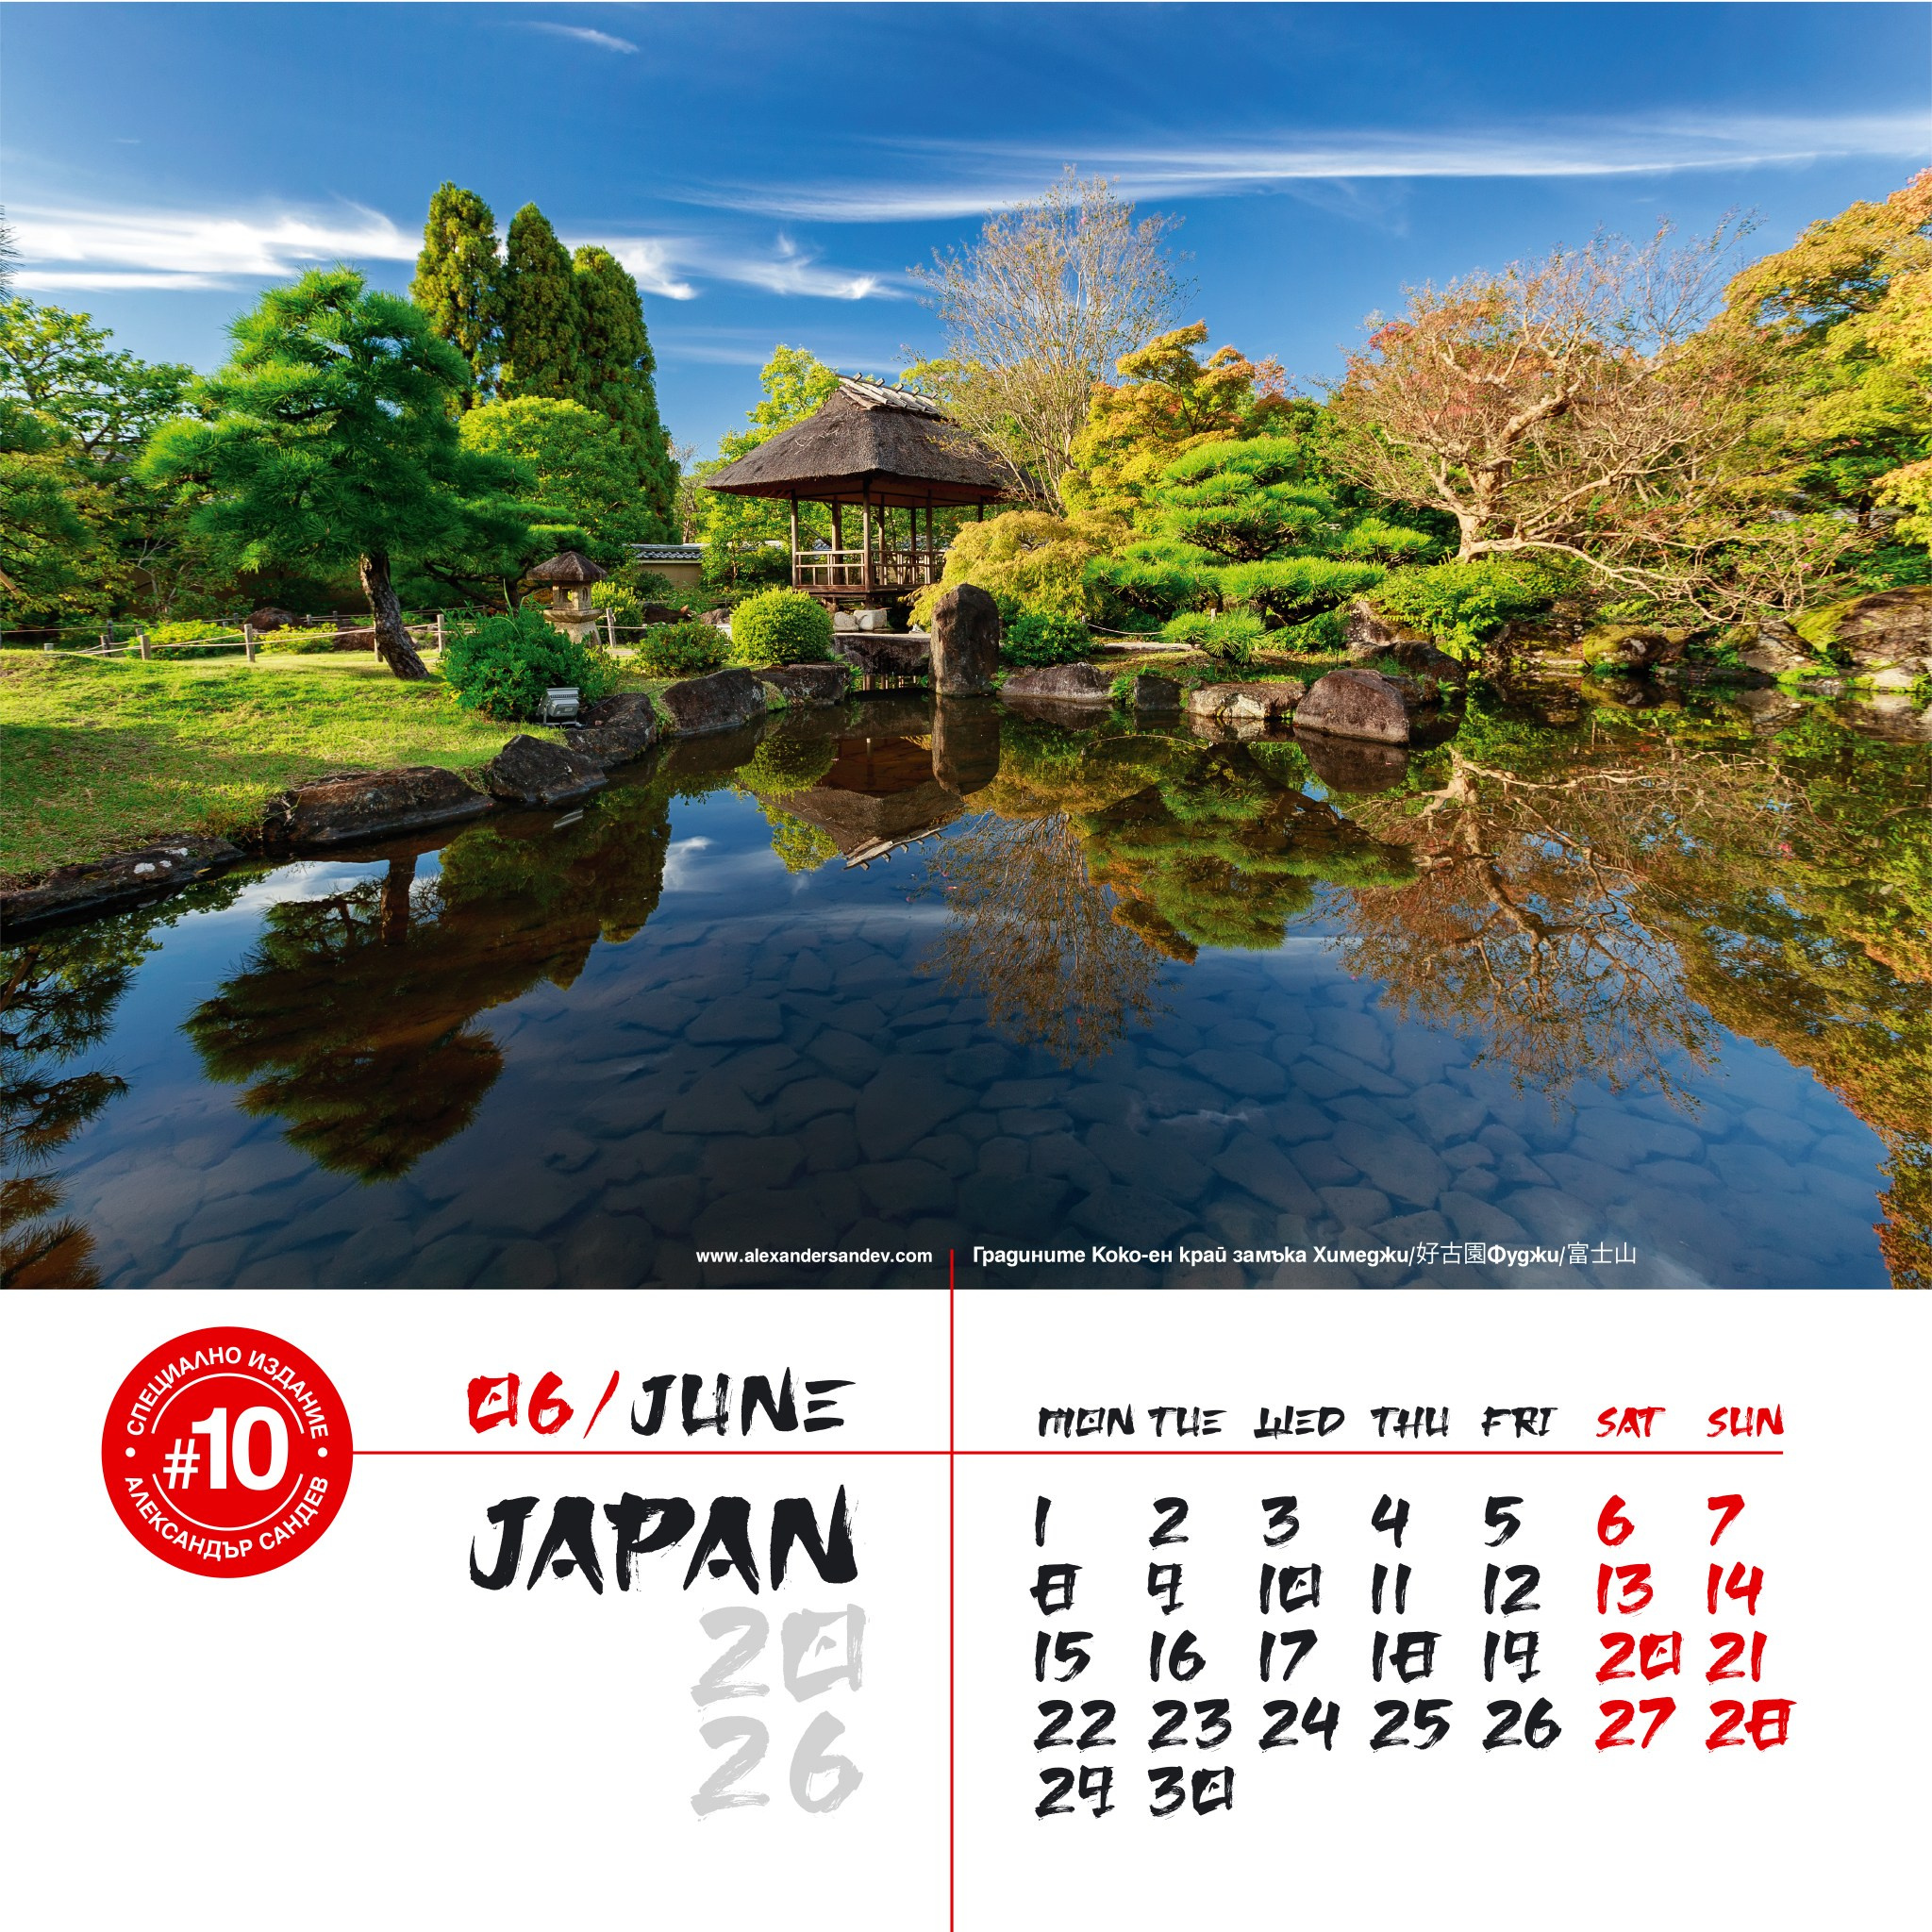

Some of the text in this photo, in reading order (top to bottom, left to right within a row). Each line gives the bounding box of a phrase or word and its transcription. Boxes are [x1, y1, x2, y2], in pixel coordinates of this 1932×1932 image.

[126, 1346, 329, 1440] СПЕЦИАЛНО ИЗДАНИЕ
[1039, 1404, 1784, 1440] MON TUE WED THU FRI SAT SUN
[162, 1406, 289, 1491] #10
[125, 1476, 329, 1561] АЛЕКСАНДЪР САНДЕВ
[470, 1484, 858, 1595] JAPAN
[1035, 1494, 1745, 1551] 1 2 3 4 5 6 7
[1029, 1562, 1764, 1618] 8 9 10 11 12 13 14
[690, 1604, 868, 1707] 20
[1035, 1629, 1768, 1686] 15 16 17 18 19 20 21
[1033, 1696, 1797, 1754] 22 23 24 25 26 27 28
[690, 1710, 864, 1819] 26
[1035, 1765, 1237, 1821] 29 30
